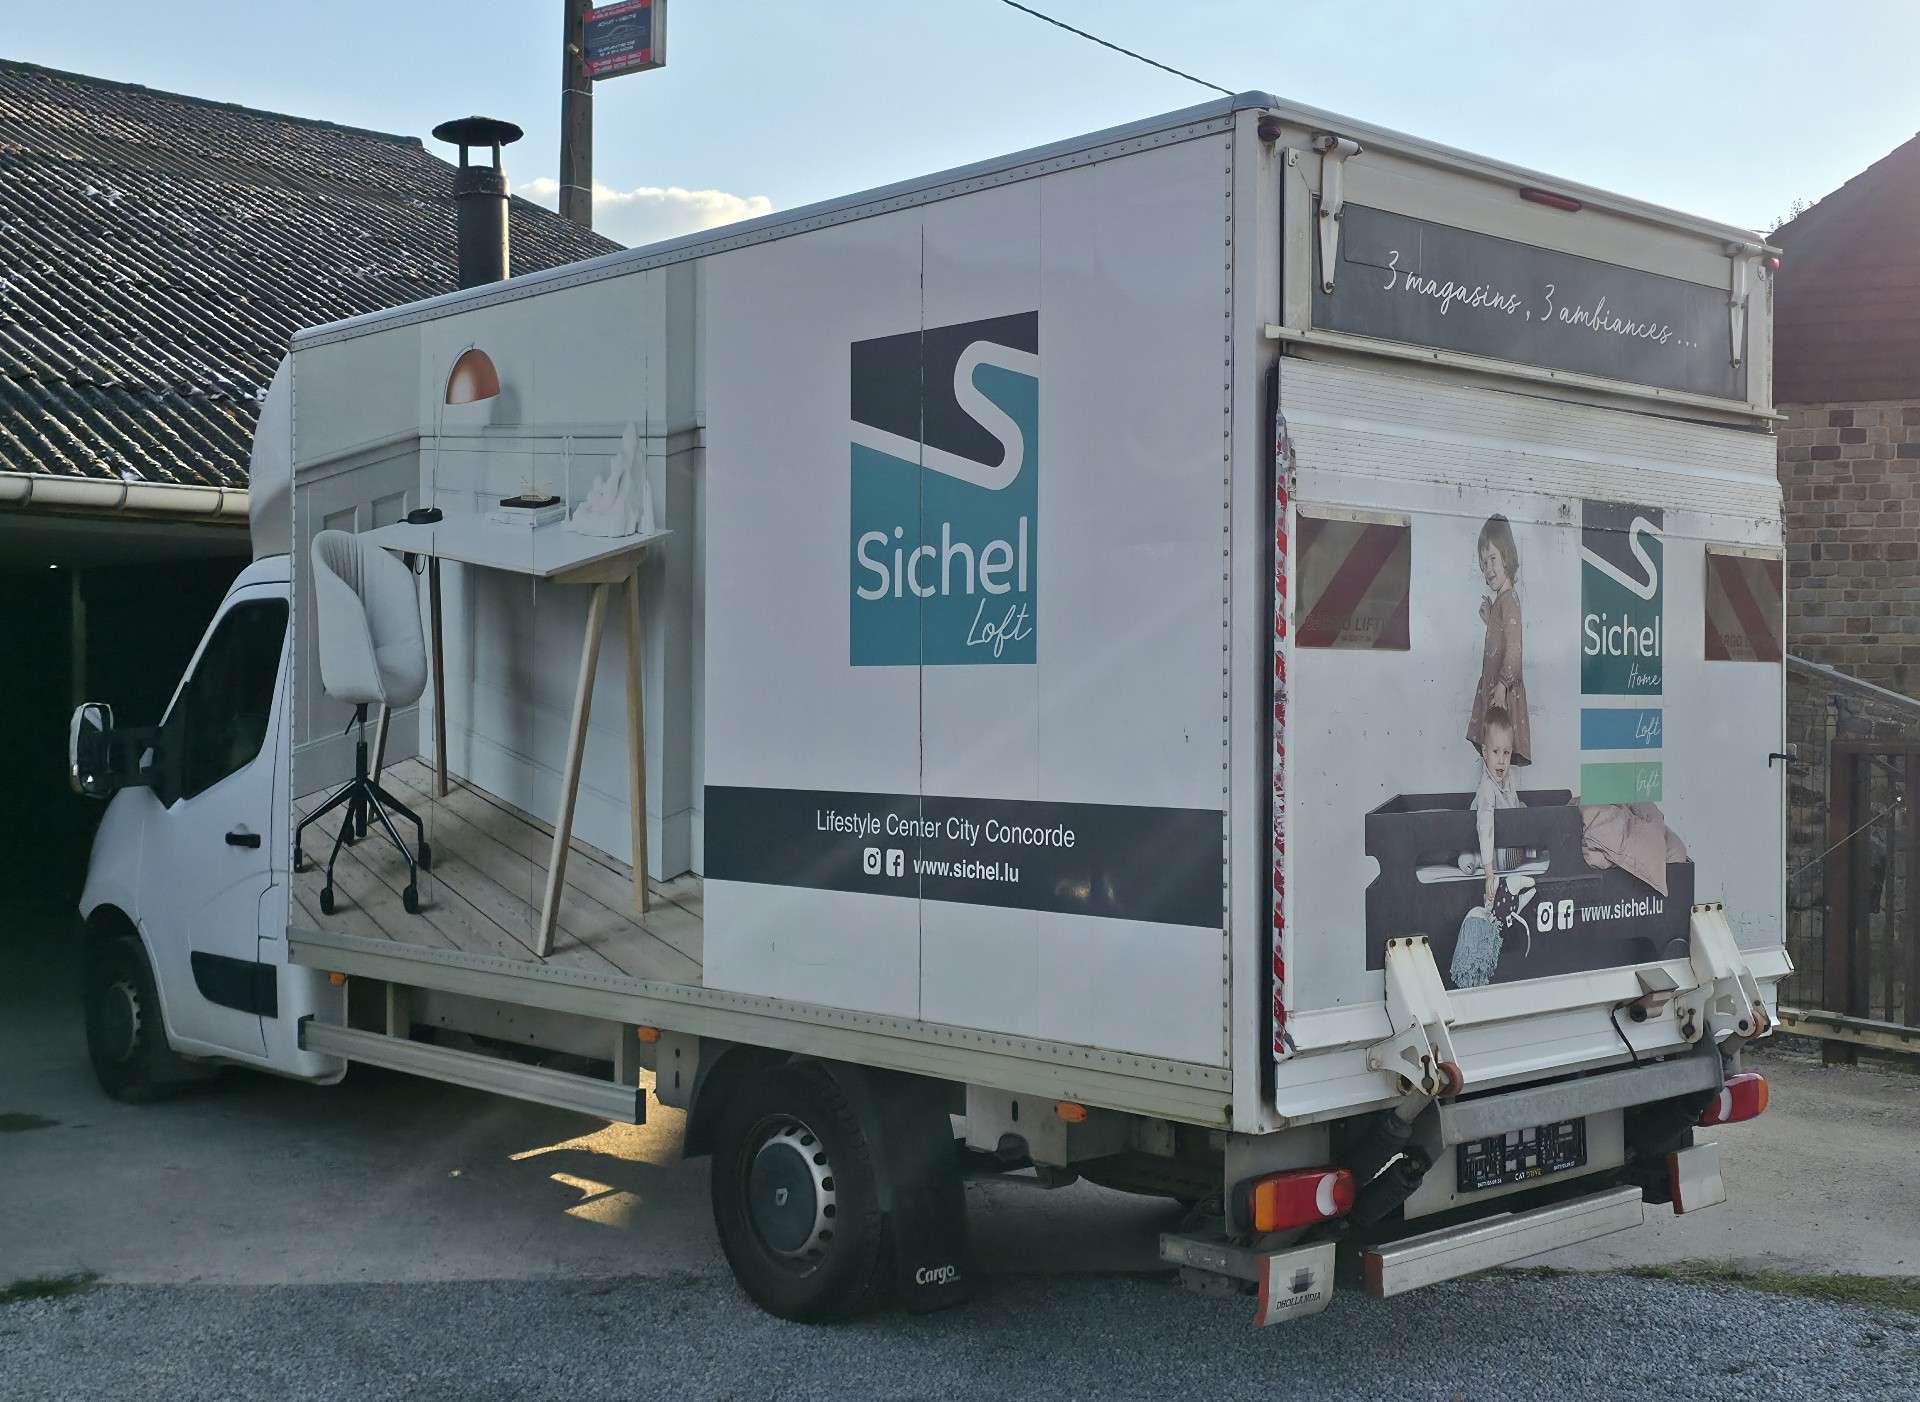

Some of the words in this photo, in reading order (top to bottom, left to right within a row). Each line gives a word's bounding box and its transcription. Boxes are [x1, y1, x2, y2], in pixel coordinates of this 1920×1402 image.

[1383, 250, 1400, 290] 3
[1540, 283, 1556, 321] 3
[856, 515, 1028, 600] Sichel
[966, 597, 1033, 658] Loft
[1583, 612, 1660, 657] Sichel
[1627, 661, 1661, 689] Home
[1635, 711, 1661, 745] Loft
[816, 809, 881, 839] Lifestyle
[885, 813, 942, 839] Center
[946, 816, 980, 847] City
[985, 819, 1076, 848] Concorde
[913, 857, 1020, 883] www.sichel.lu
[1581, 895, 1664, 922] www.sichel.lu
[916, 1265, 955, 1285] Cargo
[1276, 1291, 1321, 1311] DHOLLANDIA
